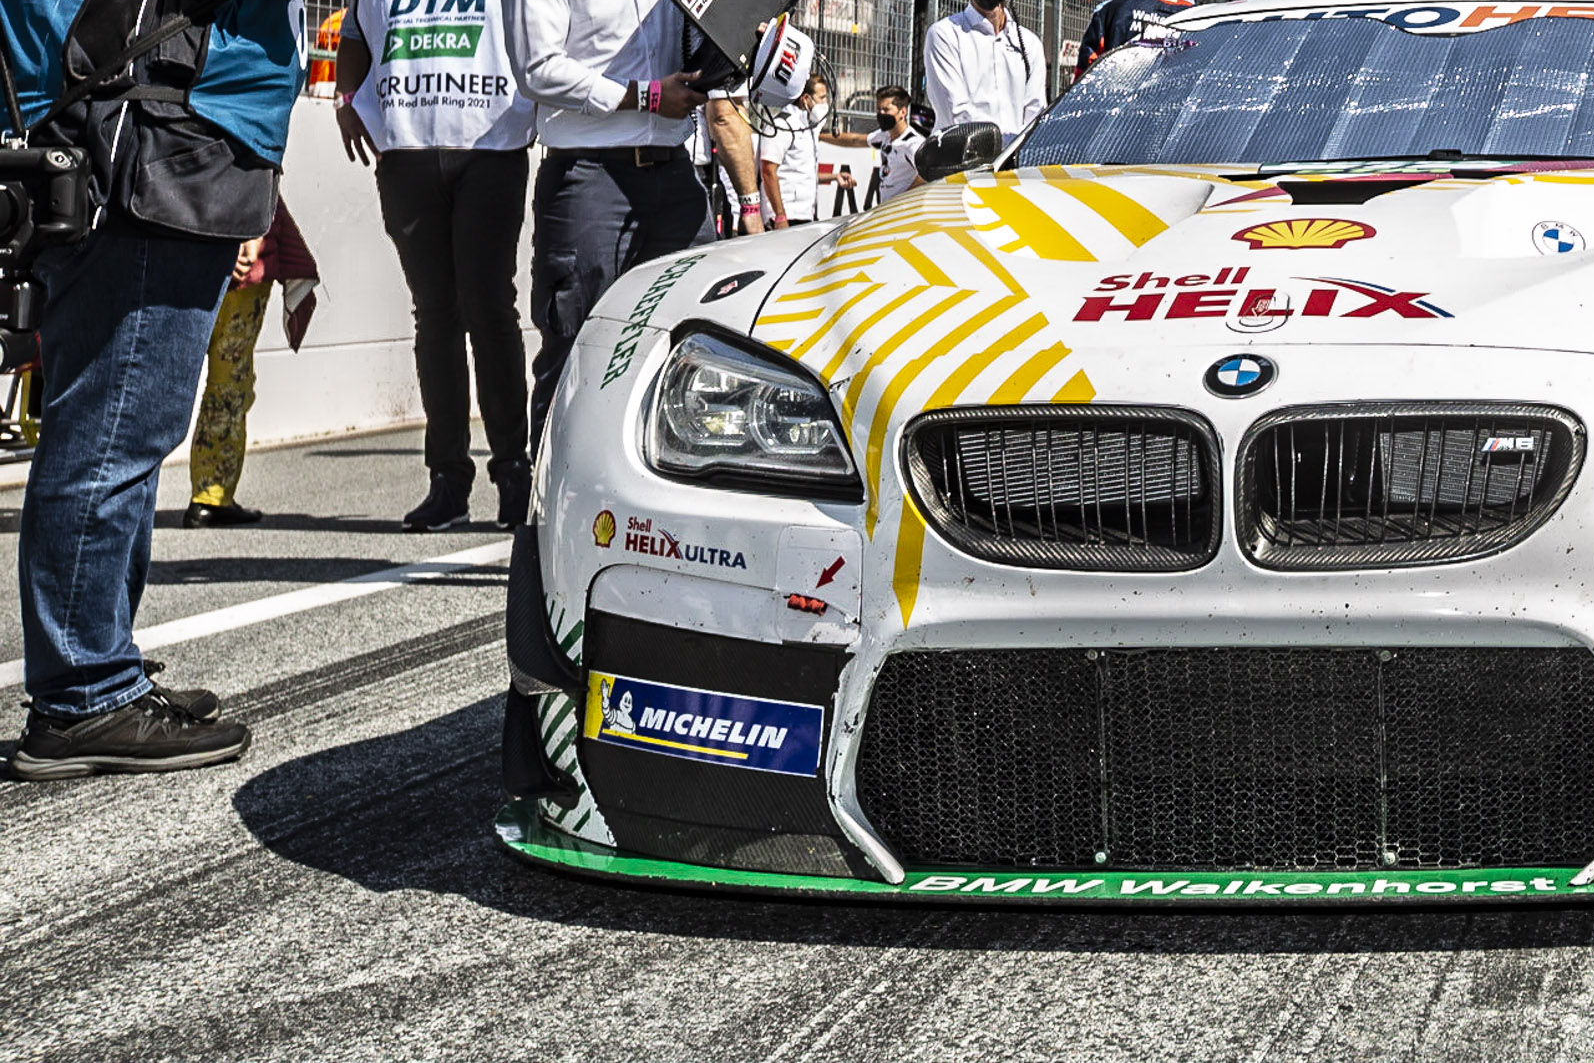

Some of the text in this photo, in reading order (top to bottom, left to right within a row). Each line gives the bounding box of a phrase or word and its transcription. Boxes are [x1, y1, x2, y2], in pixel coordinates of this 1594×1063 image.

[410, 32, 471, 51] DEKRA
[376, 72, 509, 99] CRUTINEER
[398, 97, 418, 108] Red
[420, 95, 439, 108] Bull
[441, 95, 465, 109] Ring
[467, 97, 491, 108] 2021
[1092, 266, 1251, 292] Shell
[1073, 277, 1456, 322] HELIX
[600, 253, 708, 390] SCHAEFFLER
[627, 517, 652, 533] Shell
[625, 528, 747, 570] HELIX ULTRA
[639, 705, 788, 749] MICHELIN
[908, 875, 1558, 896] BMW Walkenhorst
